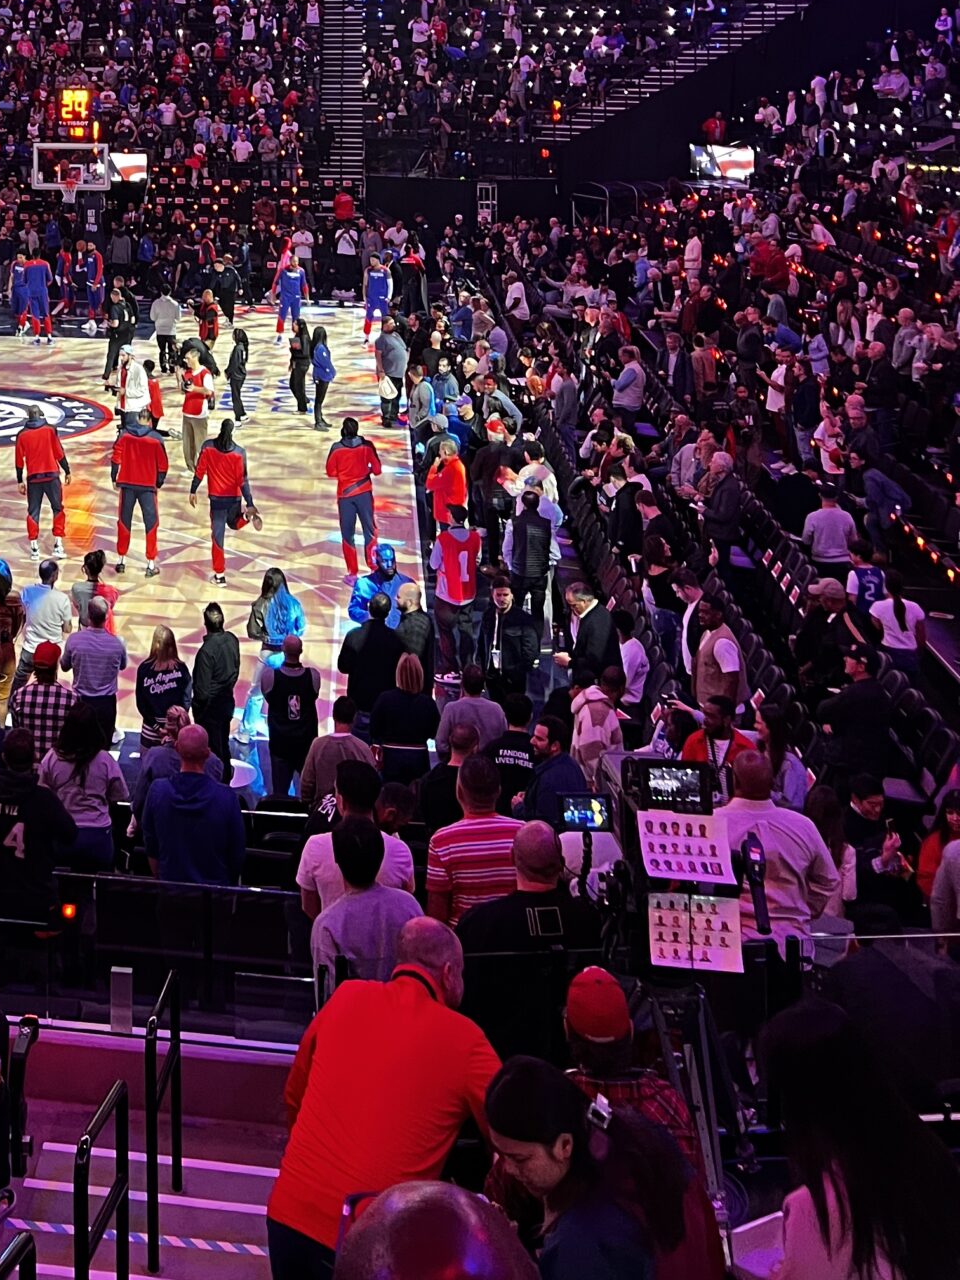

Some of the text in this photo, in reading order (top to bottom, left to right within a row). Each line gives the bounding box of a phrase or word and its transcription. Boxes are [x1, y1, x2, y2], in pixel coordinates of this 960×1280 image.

[143, 677, 154, 687] Los
[499, 749, 529, 760] FANDOM
[495, 756, 515, 765] LIVES
